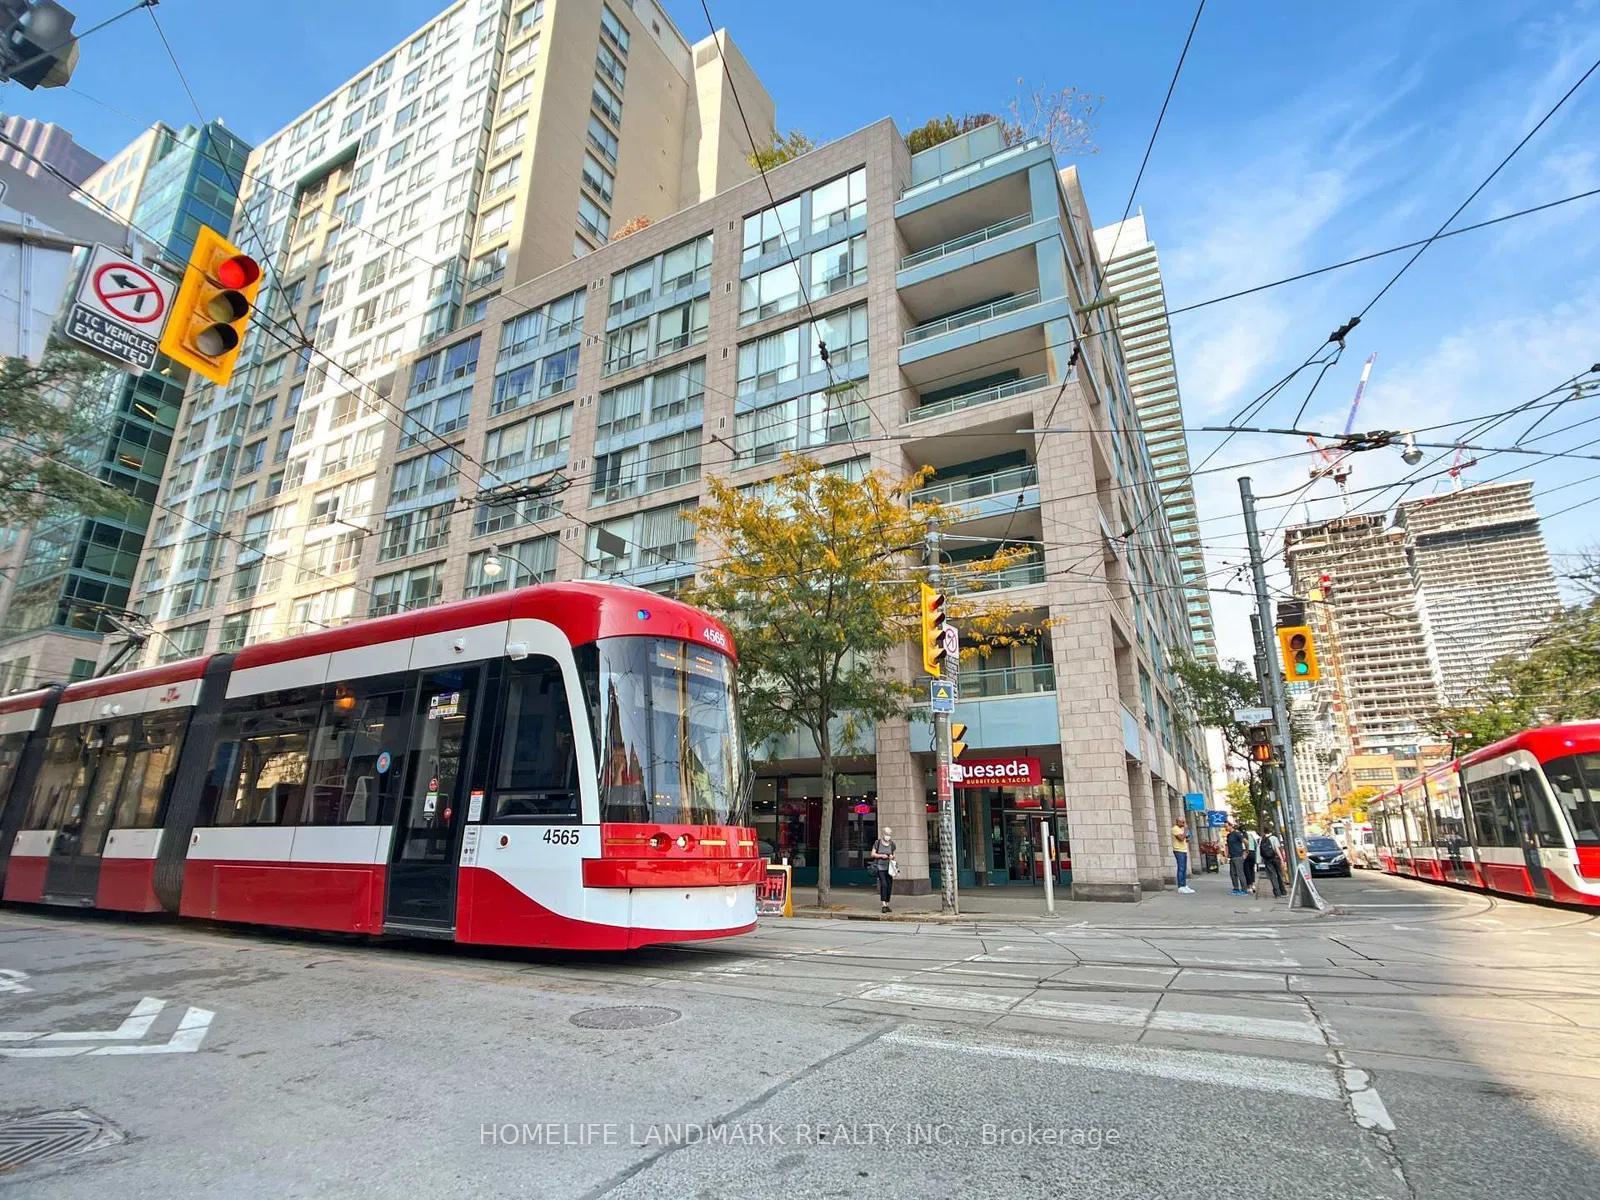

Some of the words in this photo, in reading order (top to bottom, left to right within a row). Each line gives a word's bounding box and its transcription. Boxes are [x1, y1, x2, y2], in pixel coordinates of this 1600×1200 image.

[76, 308, 100, 328] TTC
[104, 322, 156, 354] VEHICLES
[74, 322, 148, 363] EXCEPTED
[703, 627, 726, 646] 4565
[962, 760, 1030, 778] uesada
[543, 828, 580, 845] 4565
